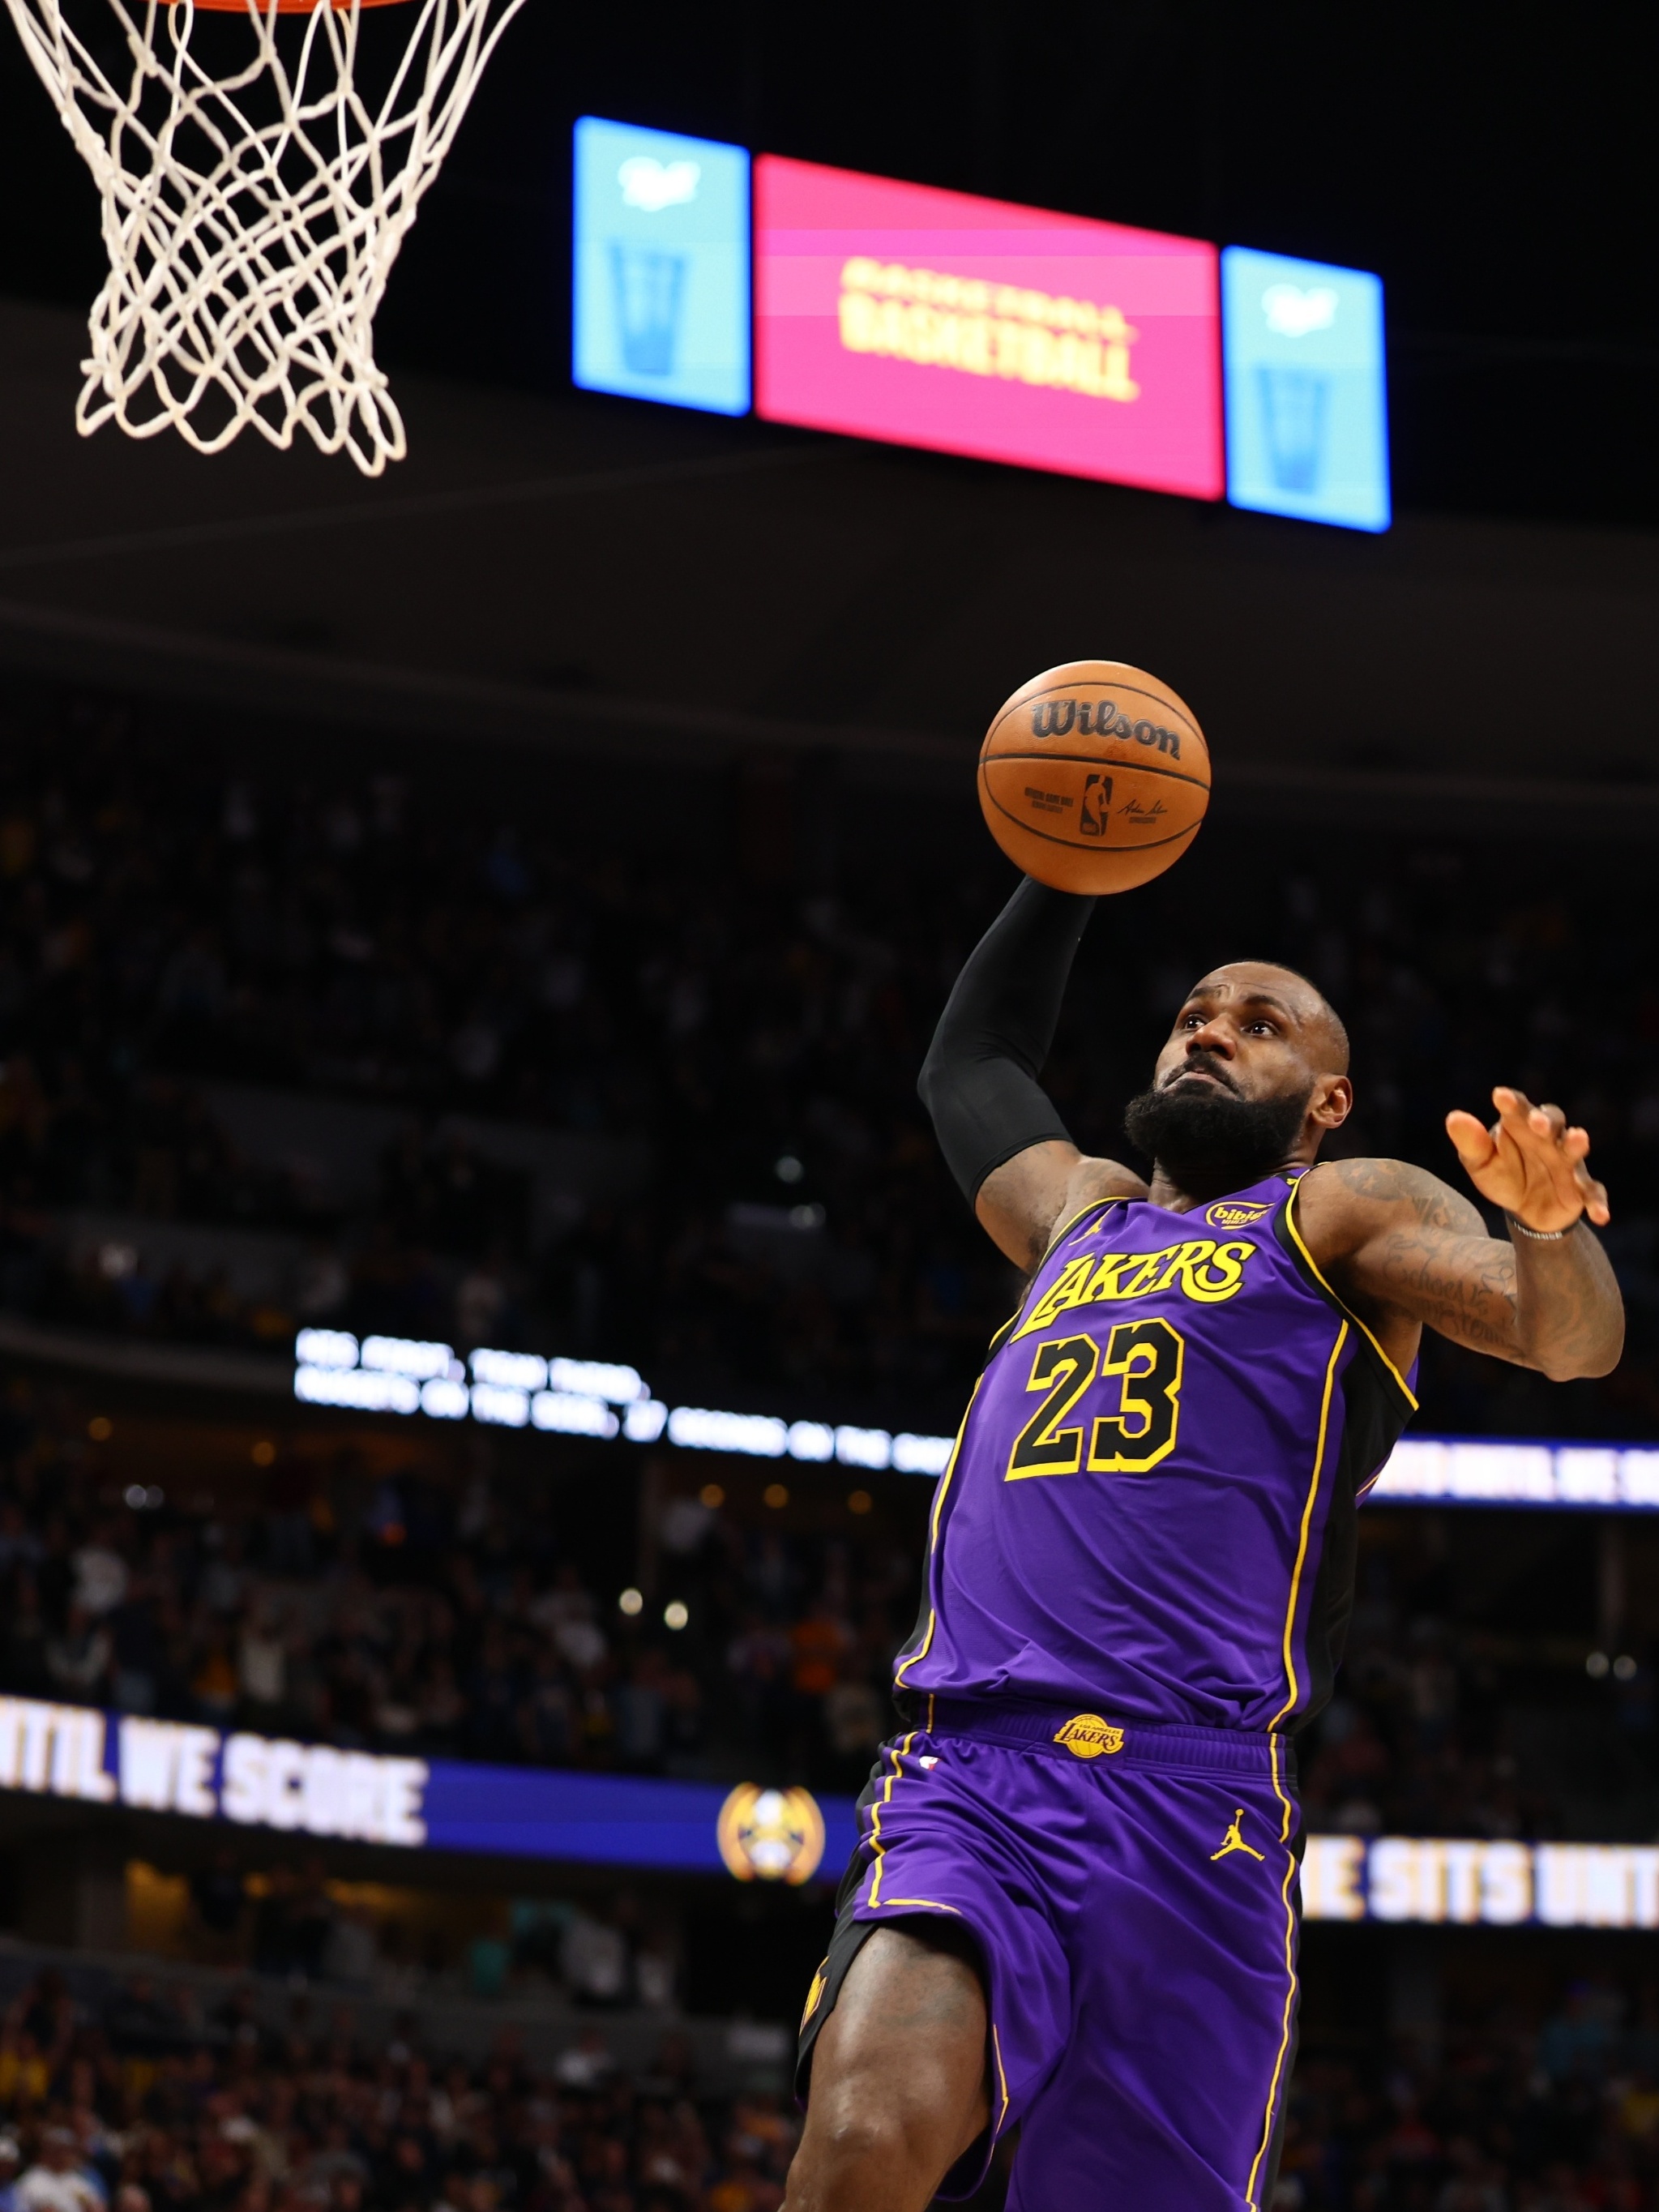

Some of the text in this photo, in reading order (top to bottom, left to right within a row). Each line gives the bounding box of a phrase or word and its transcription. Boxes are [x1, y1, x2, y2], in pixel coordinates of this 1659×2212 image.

[1030, 699, 1181, 761] Wilson
[1009, 1240, 1258, 1346] LAKERS
[1003, 1316, 1185, 1483] 23
[118, 1714, 220, 1819] WE
[221, 1731, 429, 1848] SCORE
[1059, 1722, 1121, 1752] LAKERS
[1367, 1835, 1532, 1925] SITS
